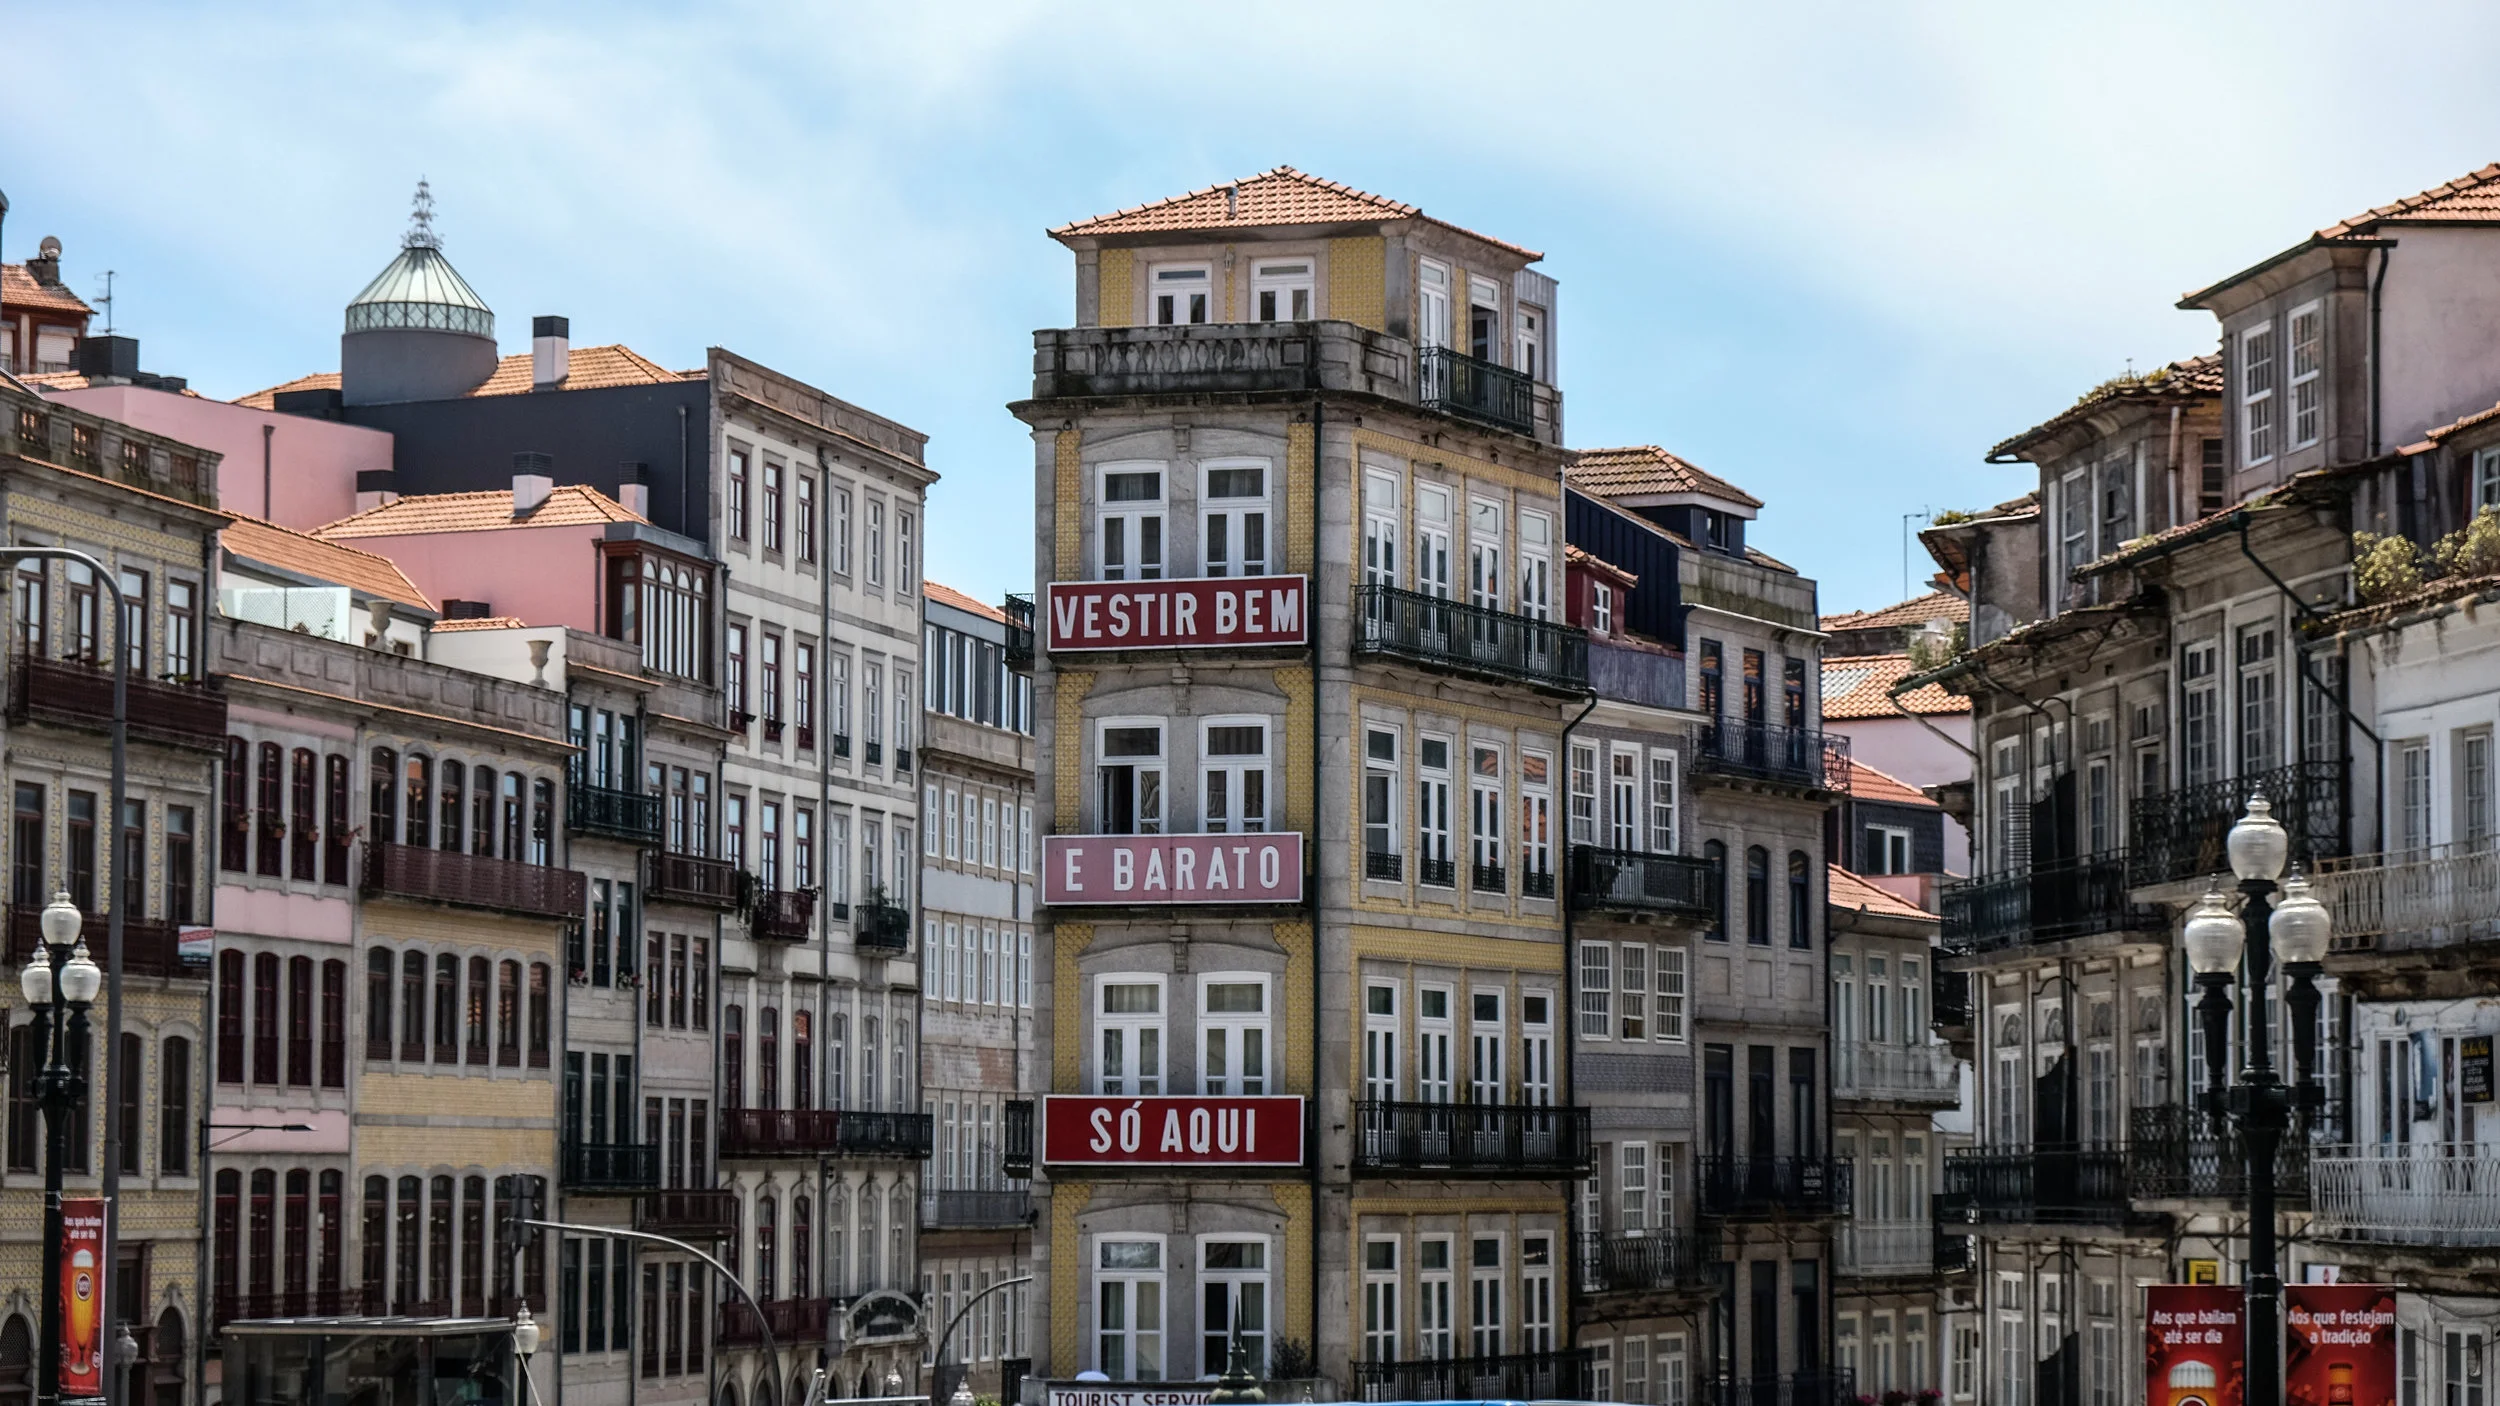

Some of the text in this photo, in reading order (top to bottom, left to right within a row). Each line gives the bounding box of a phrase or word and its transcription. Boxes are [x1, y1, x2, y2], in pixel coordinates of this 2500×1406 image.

[1054, 588, 1299, 640] VESTIR BEM
[1065, 846, 1280, 892] E BARATO
[1089, 1101, 1256, 1154] SÓ AQUI
[2152, 1309, 2236, 1328] Aos que bailam
[2288, 1309, 2394, 1329] Aos que festejam
[2164, 1328, 2223, 1344] até ser dia
[2309, 1329, 2371, 1347] a tradição
[1055, 1392, 1134, 1406] TOURIST
